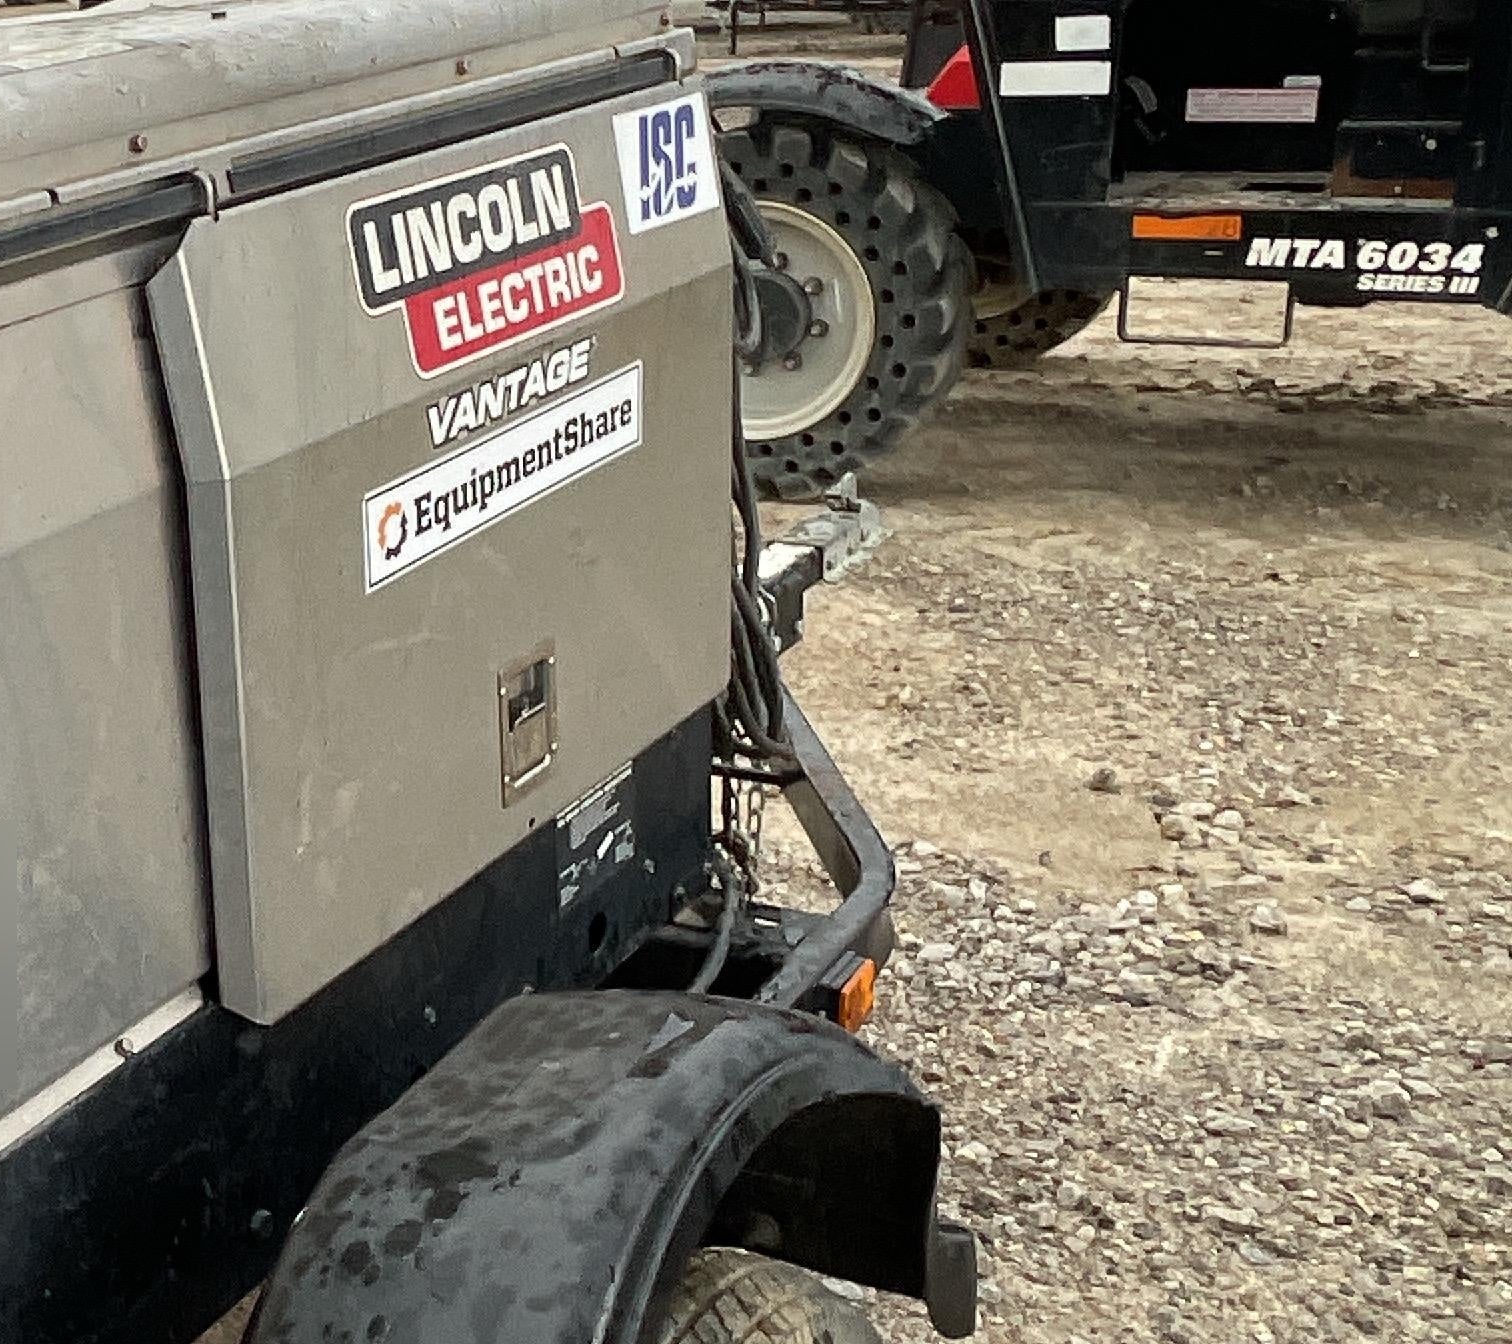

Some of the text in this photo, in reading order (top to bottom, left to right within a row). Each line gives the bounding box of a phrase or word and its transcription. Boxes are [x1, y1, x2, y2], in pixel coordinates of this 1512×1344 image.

[362, 163, 572, 295] LINCOLN
[1244, 237, 1486, 274] MTA 6034
[1356, 273, 1446, 293] SERIES
[432, 244, 604, 352] ELECTRIC
[426, 338, 592, 449] VANTAGE
[413, 398, 633, 538] EquipmentShare
